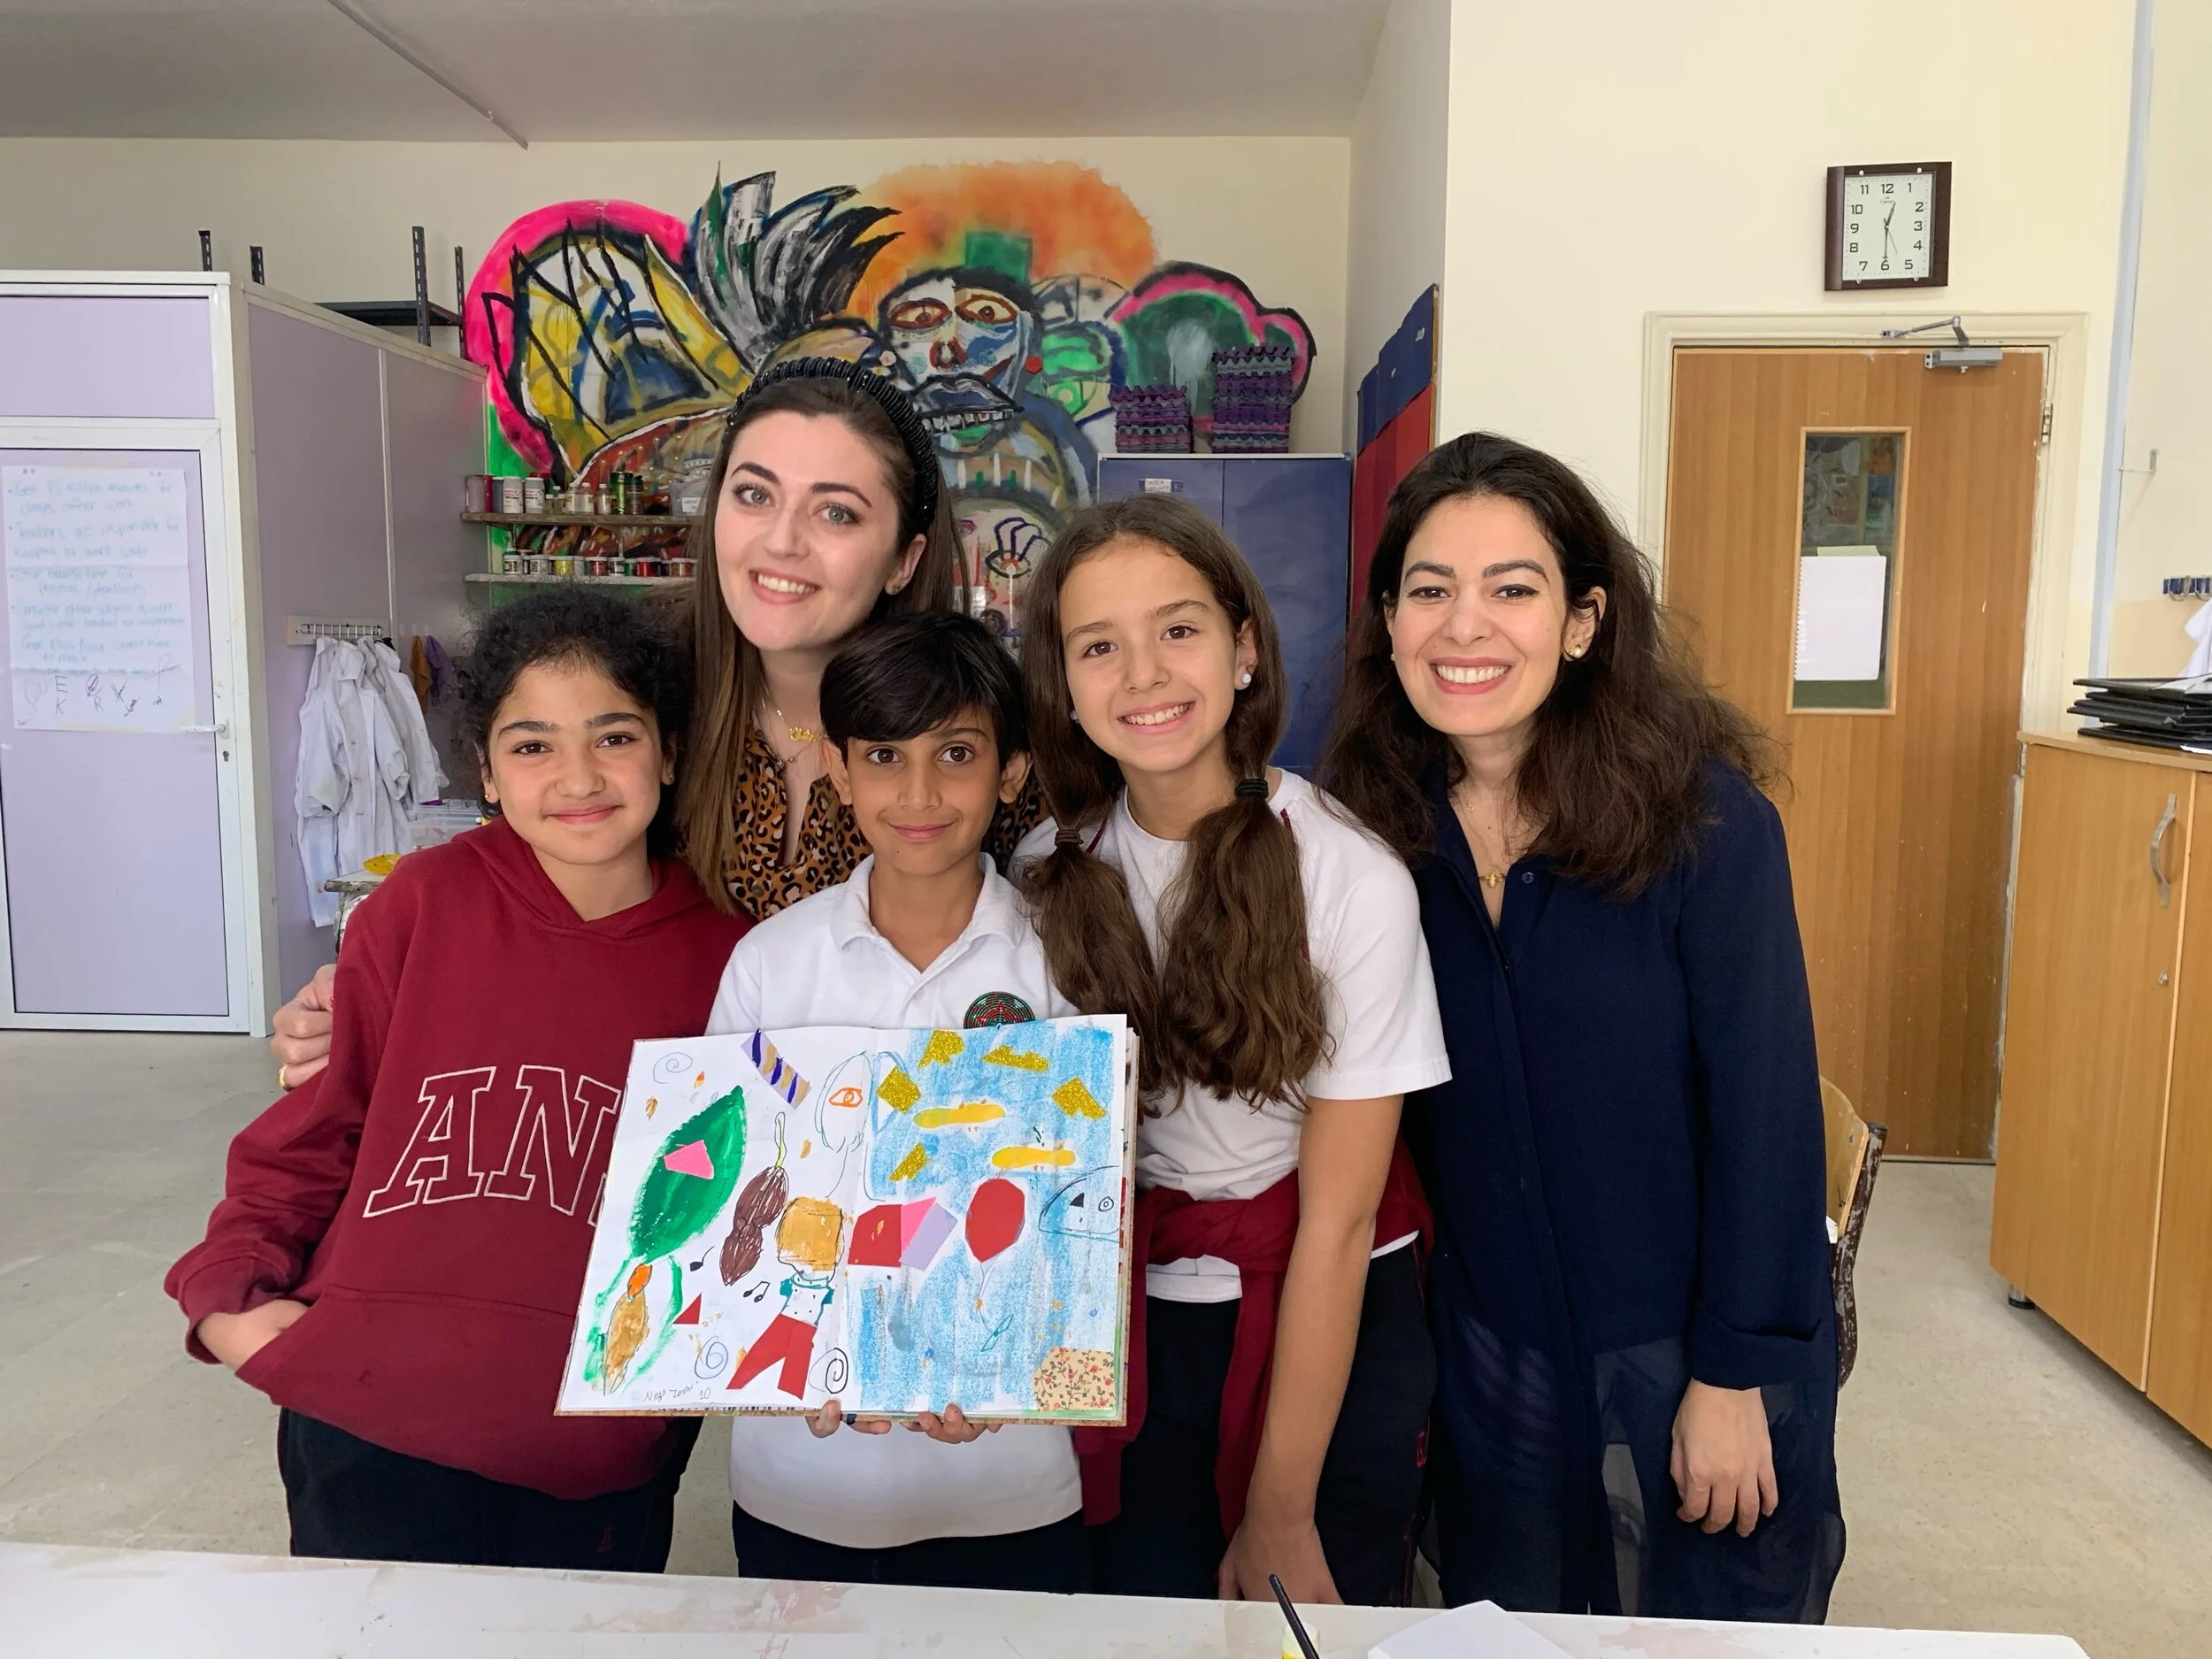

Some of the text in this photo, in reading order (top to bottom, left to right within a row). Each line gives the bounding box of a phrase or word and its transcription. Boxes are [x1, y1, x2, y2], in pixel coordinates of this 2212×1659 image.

[1860, 184, 1869, 195] 11
[1881, 183, 1894, 194] 12
[1908, 182, 1912, 193] 1
[1851, 204, 1863, 215] 10
[1915, 202, 1924, 212] 2
[1850, 223, 1859, 234] 9
[1914, 221, 1923, 231] 3
[1849, 242, 1858, 252] 8
[1913, 240, 1923, 250] 4
[1859, 261, 1868, 271] 7
[1880, 260, 1890, 271] 6
[1904, 259, 1914, 270] 5
[362, 1064, 622, 1227] AN
[698, 1386, 712, 1400] 10
